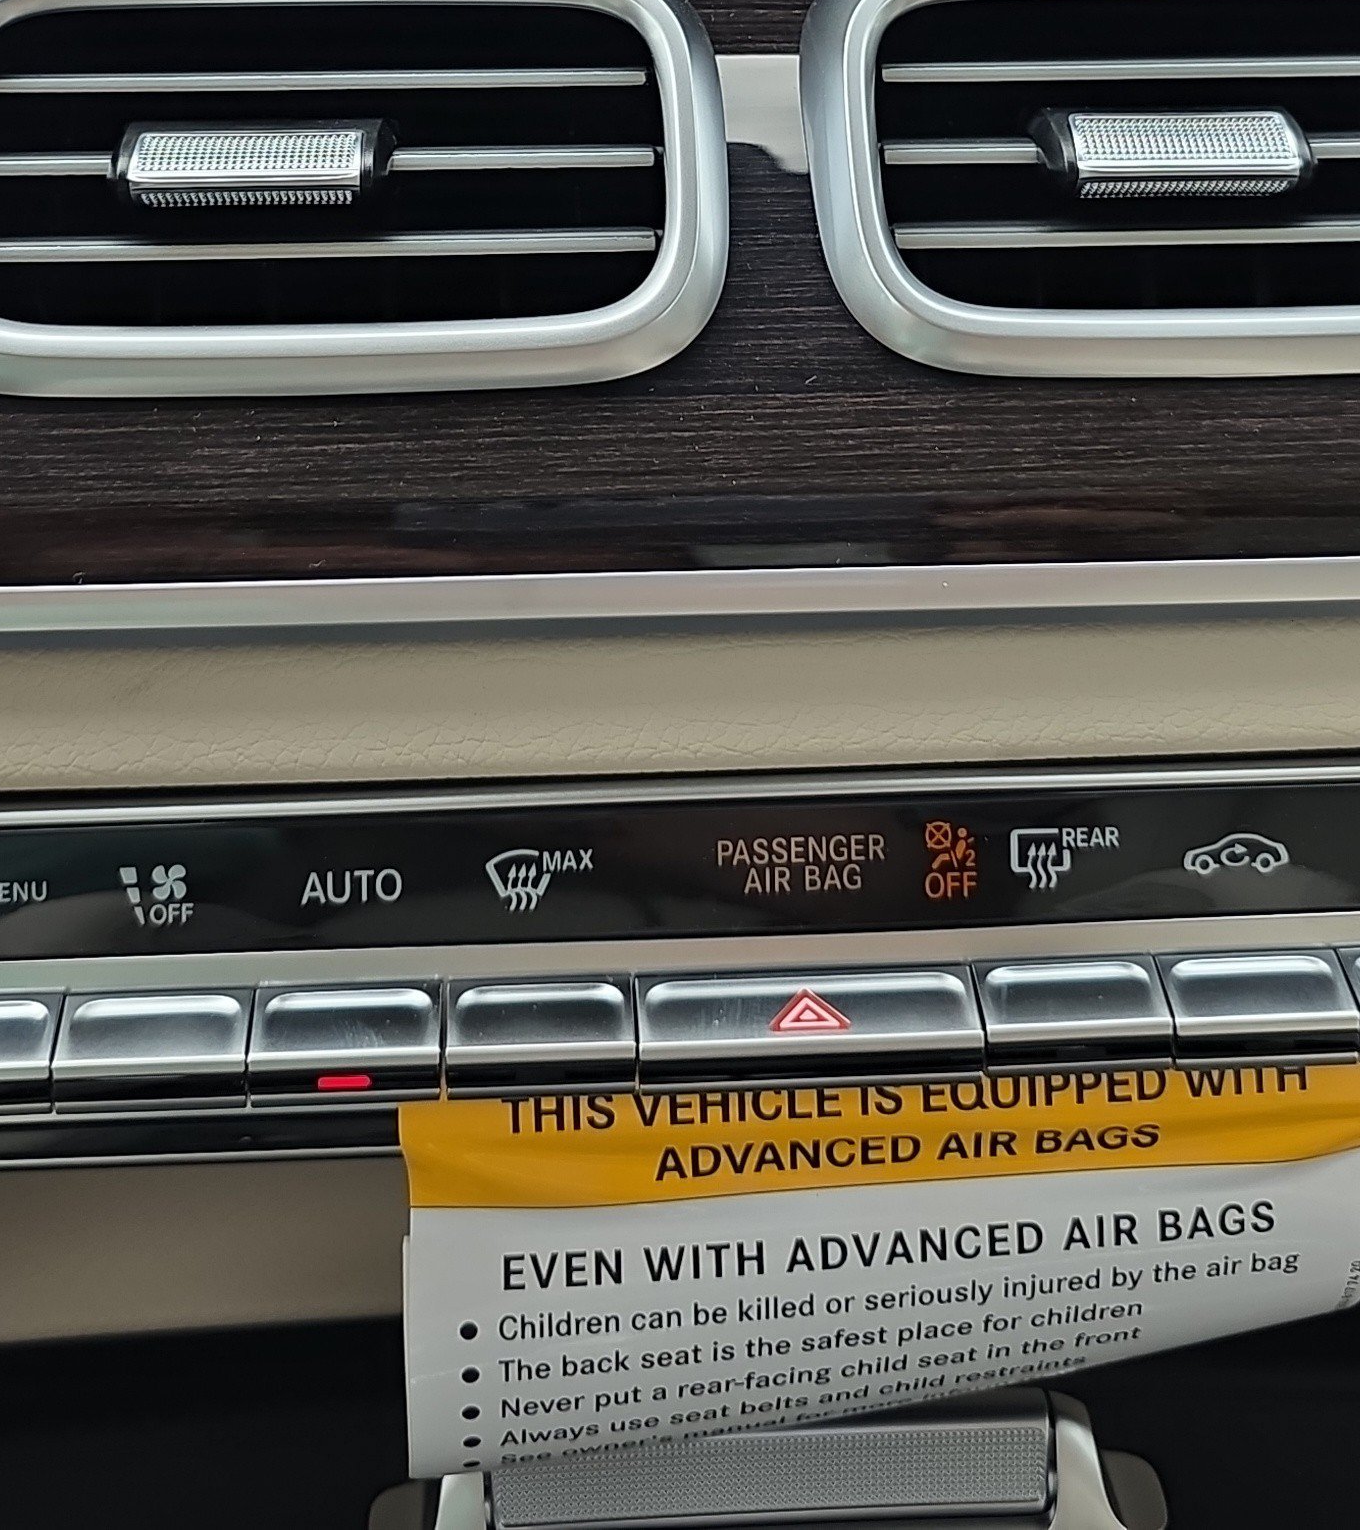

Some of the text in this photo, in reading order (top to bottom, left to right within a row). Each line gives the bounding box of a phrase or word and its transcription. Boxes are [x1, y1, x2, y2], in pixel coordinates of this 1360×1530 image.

[543, 848, 595, 872] MAX
[717, 834, 886, 867] PASSENGER
[1062, 826, 1121, 849] REAR
[300, 868, 404, 906] AUTO
[743, 862, 863, 895] AIR BAG
[925, 871, 977, 899] OFF
[149, 902, 194, 926] OFF
[501, 1067, 1308, 1135] THIS VEHICLE IS EQUIPPED WITH
[655, 1123, 1161, 1182] ADVANCED AIR BAGS
[502, 1200, 1276, 1291] EVEN WITH ADVANCED AIR BAGS
[498, 1252, 1300, 1342] Children can be killed or seriously injured by the air bag
[499, 1301, 1143, 1383] The back seat is the safest place for children
[501, 1326, 1143, 1419] Never put a rear-facing child seat in the front
[500, 1422, 600, 1447] Always
[610, 1414, 661, 1433] use
[669, 1405, 731, 1425] seat
[740, 1395, 809, 1416] belts
[819, 1385, 870, 1404] and
[878, 1375, 945, 1396] child
[954, 1355, 1088, 1386] restraints
